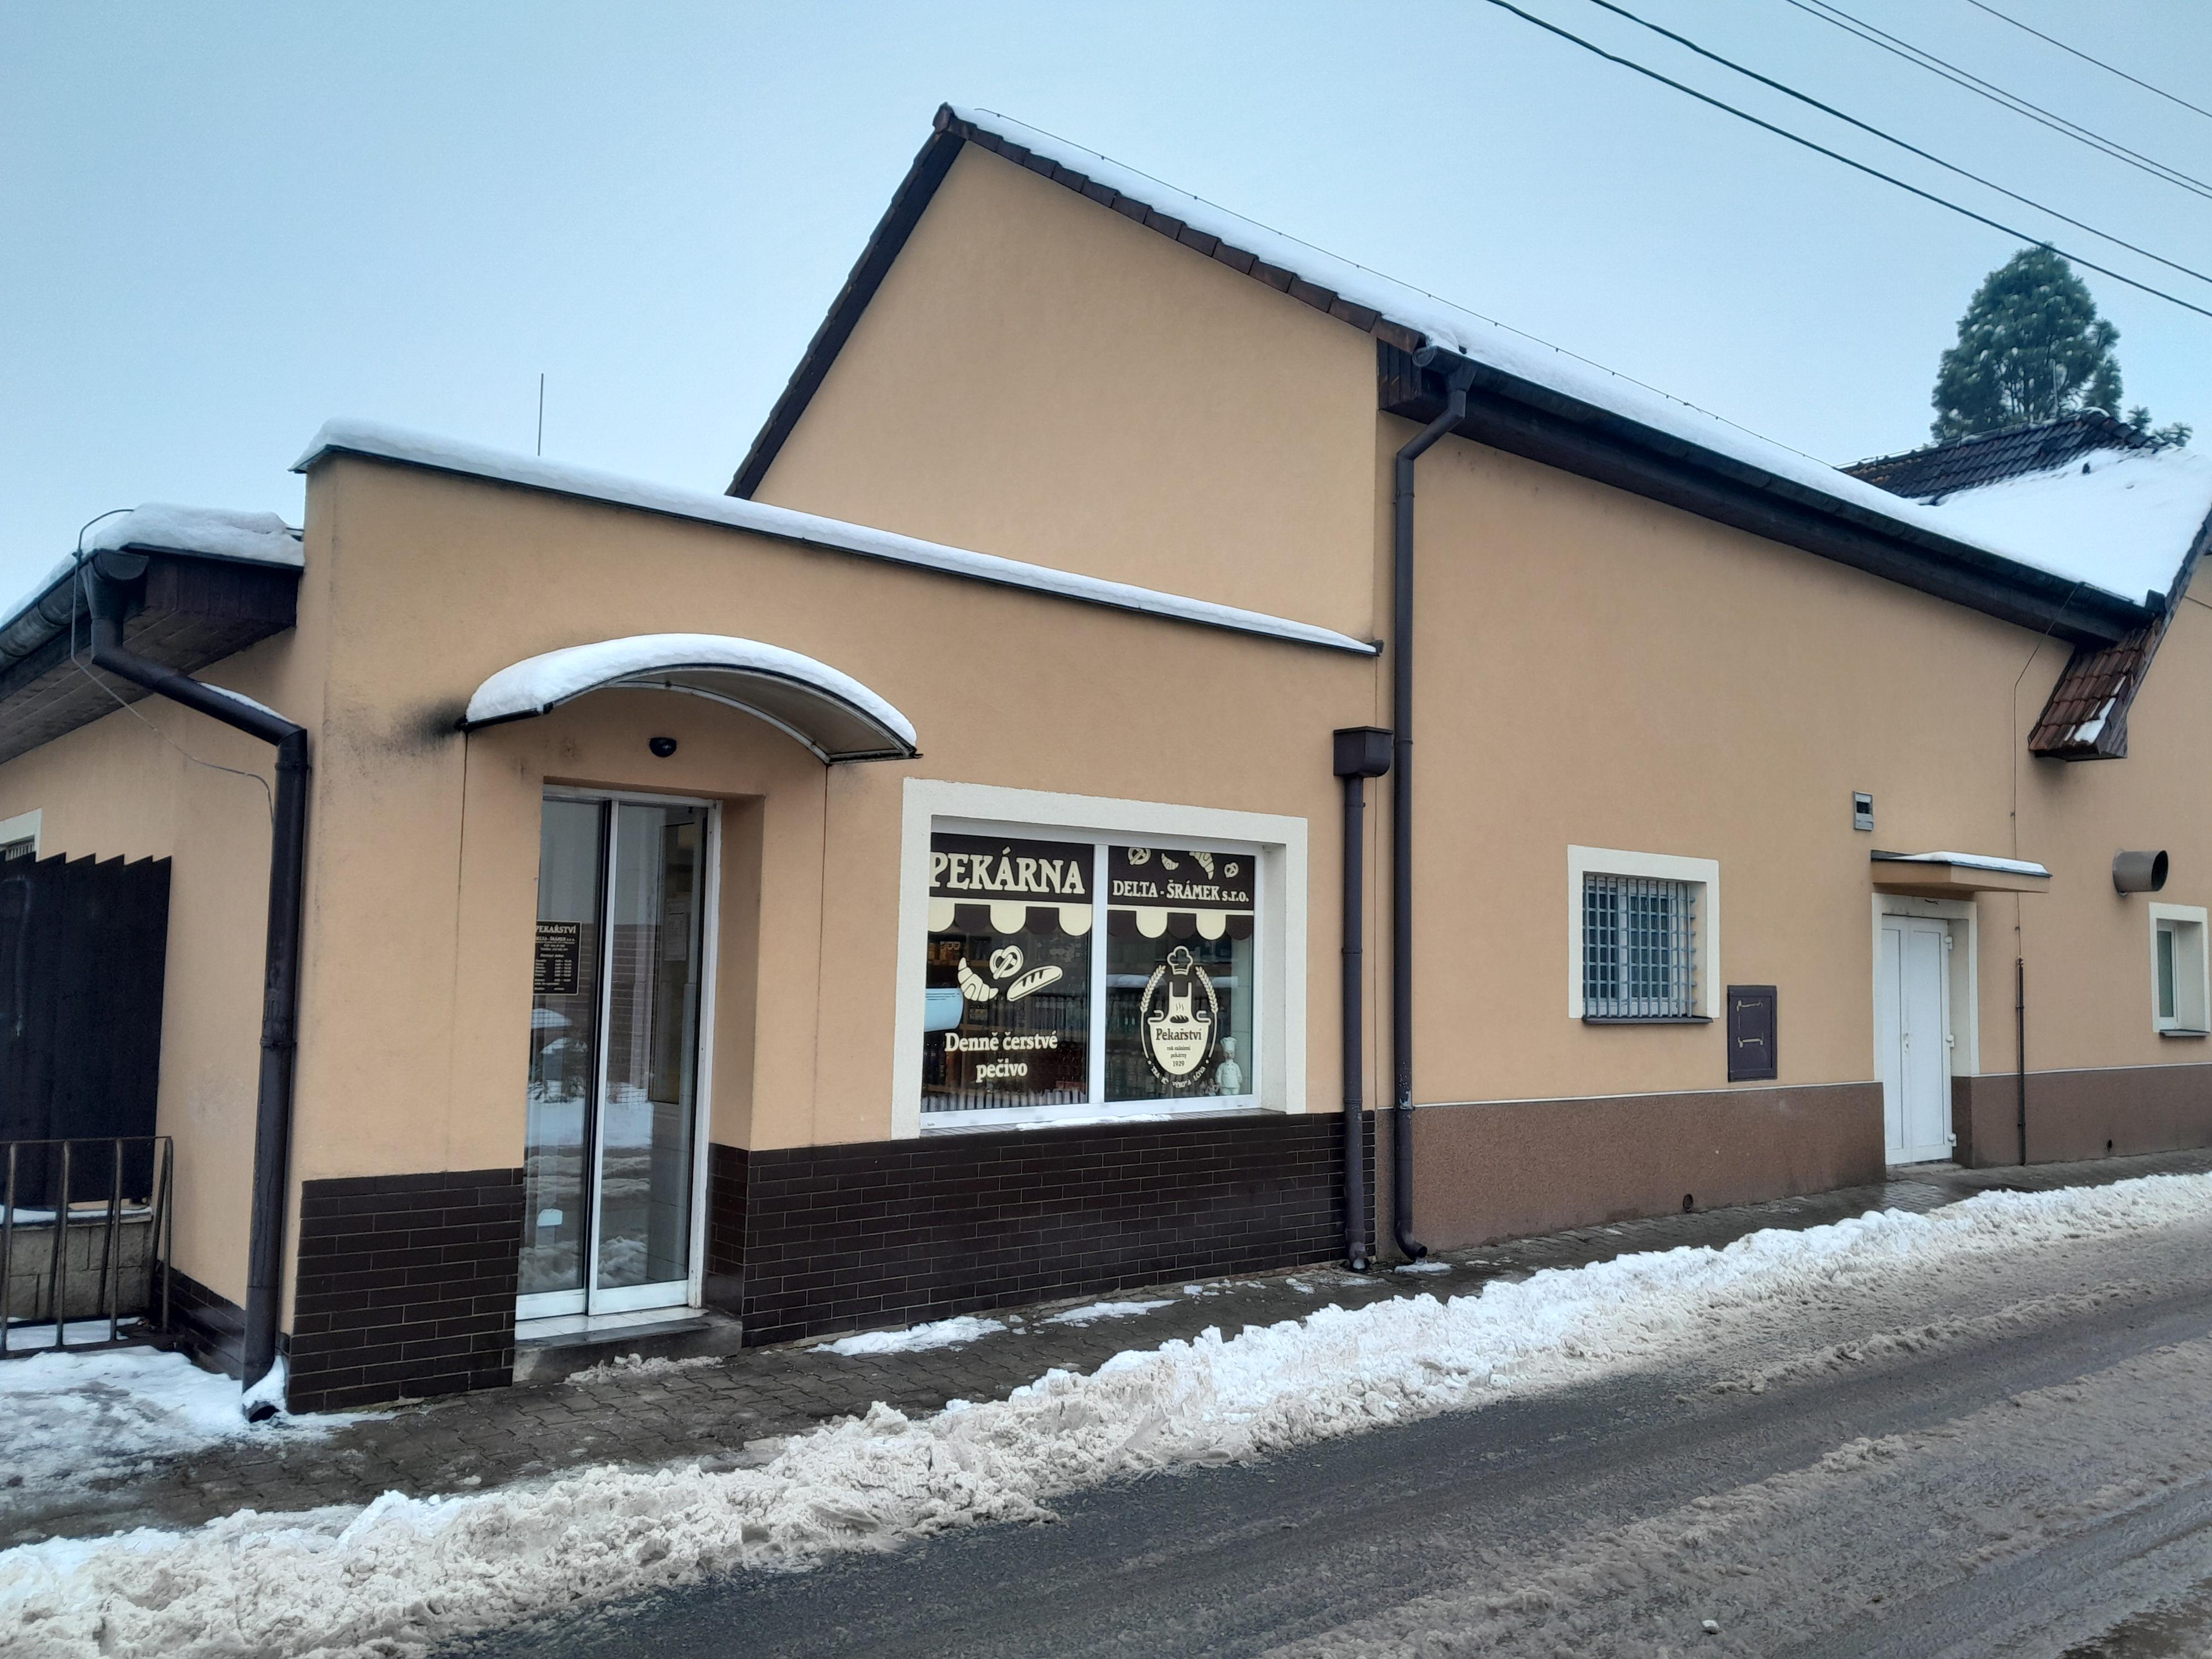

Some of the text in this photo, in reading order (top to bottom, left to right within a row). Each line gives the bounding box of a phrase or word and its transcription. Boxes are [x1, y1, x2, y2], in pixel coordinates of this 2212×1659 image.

[930, 846, 1086, 894] PEKÁRNA
[1113, 880, 1158, 897] DELTA
[1166, 879, 1220, 900] ŠRÁMEK
[1222, 891, 1249, 902] s.r.o.
[945, 1030, 1058, 1051] Denně čerstvé
[1156, 1028, 1202, 1040] Pekařství
[975, 1058, 1028, 1083] pečivo
